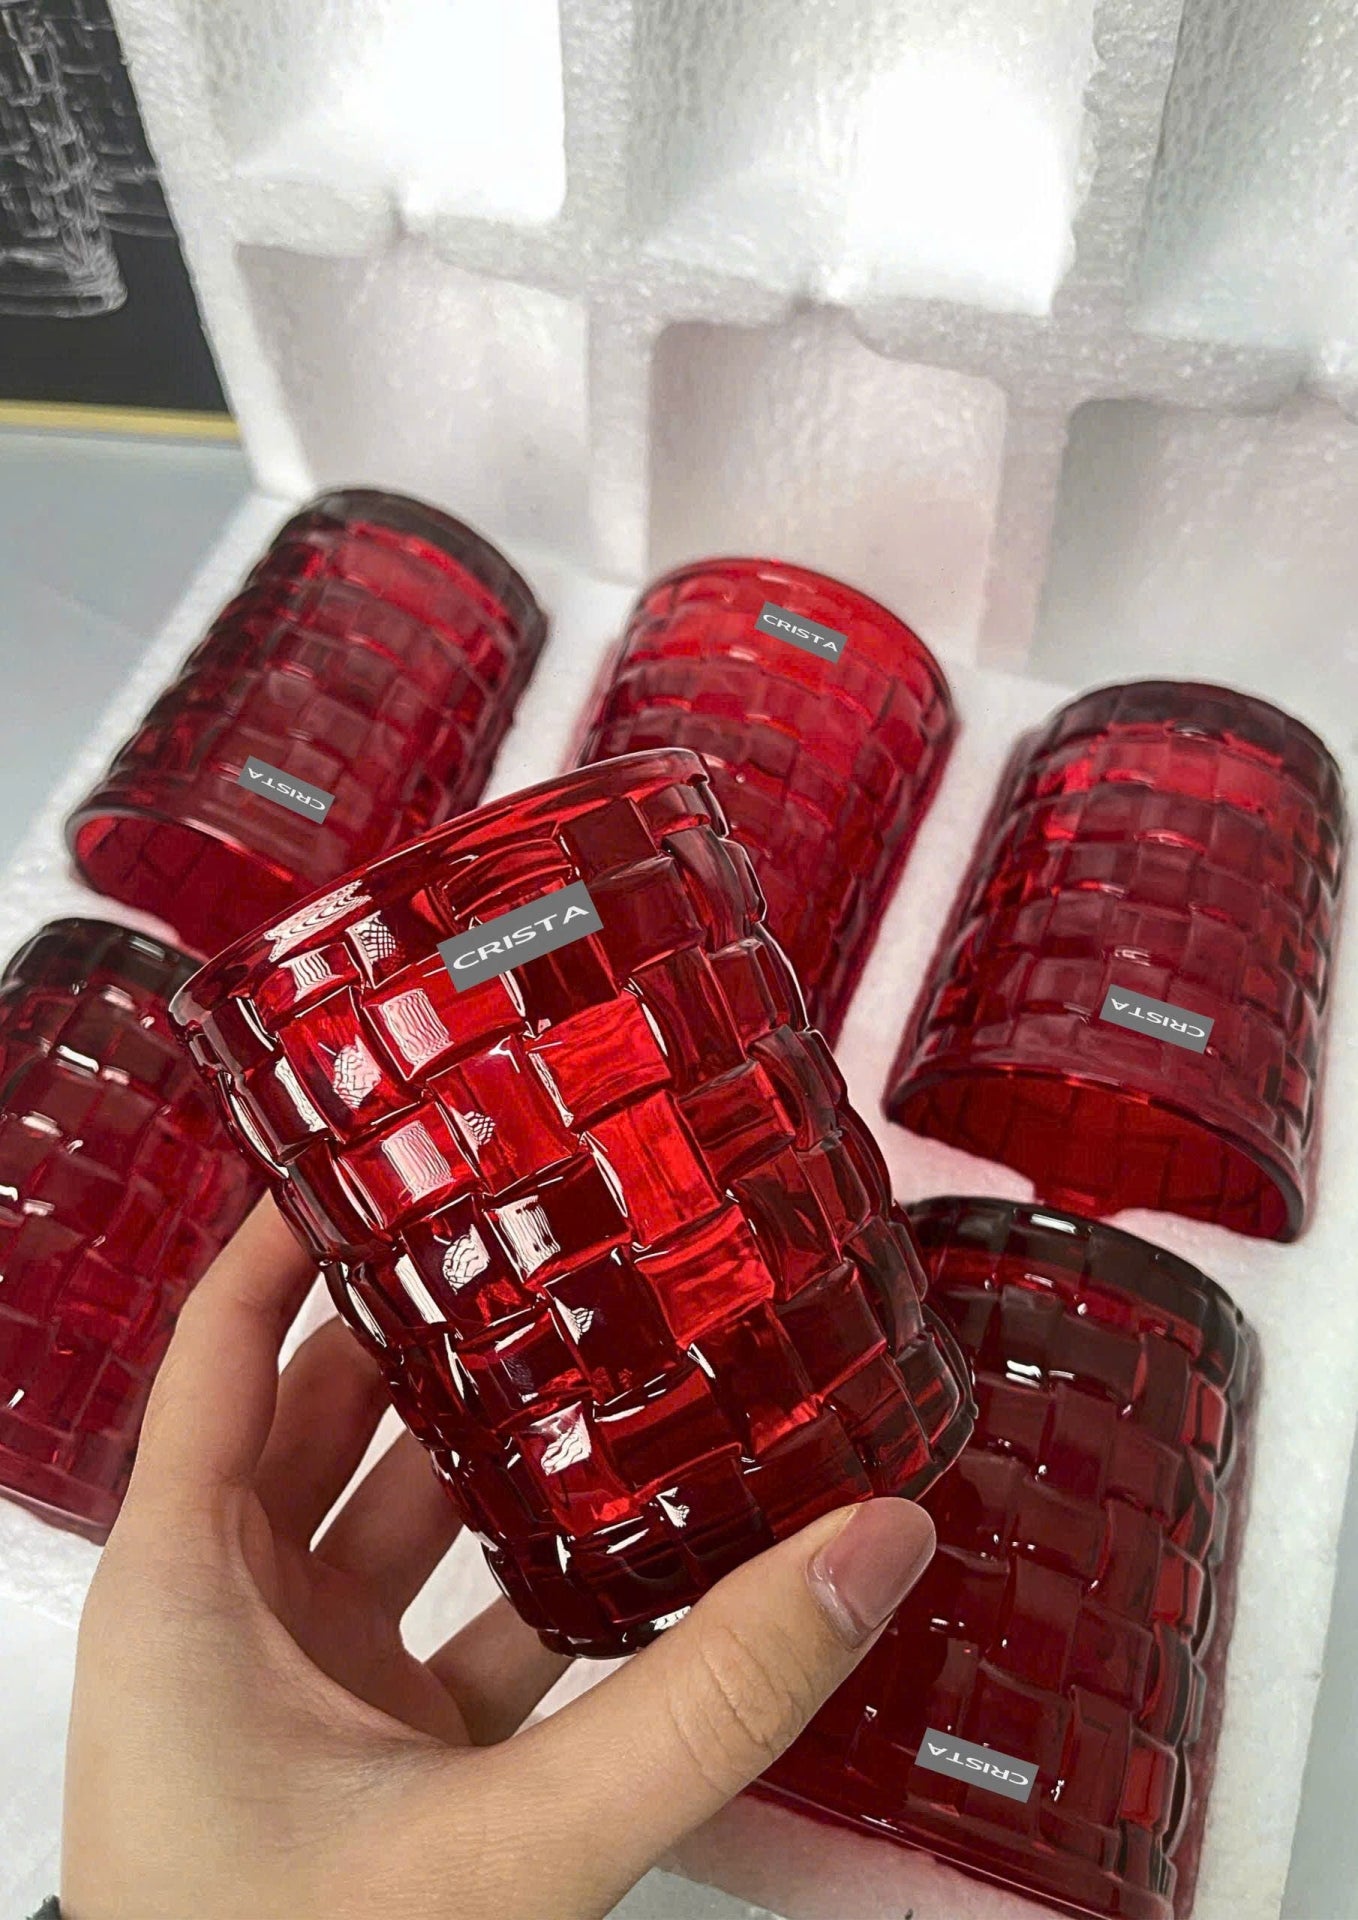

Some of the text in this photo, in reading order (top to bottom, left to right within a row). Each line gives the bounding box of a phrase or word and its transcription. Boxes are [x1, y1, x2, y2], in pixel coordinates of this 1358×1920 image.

[762, 614, 838, 653] CRISTA
[247, 767, 326, 811] CRISTA
[452, 905, 590, 970] CRISTA
[1110, 998, 1206, 1038] CRISTA
[927, 1742, 1029, 1786] CRISTA
